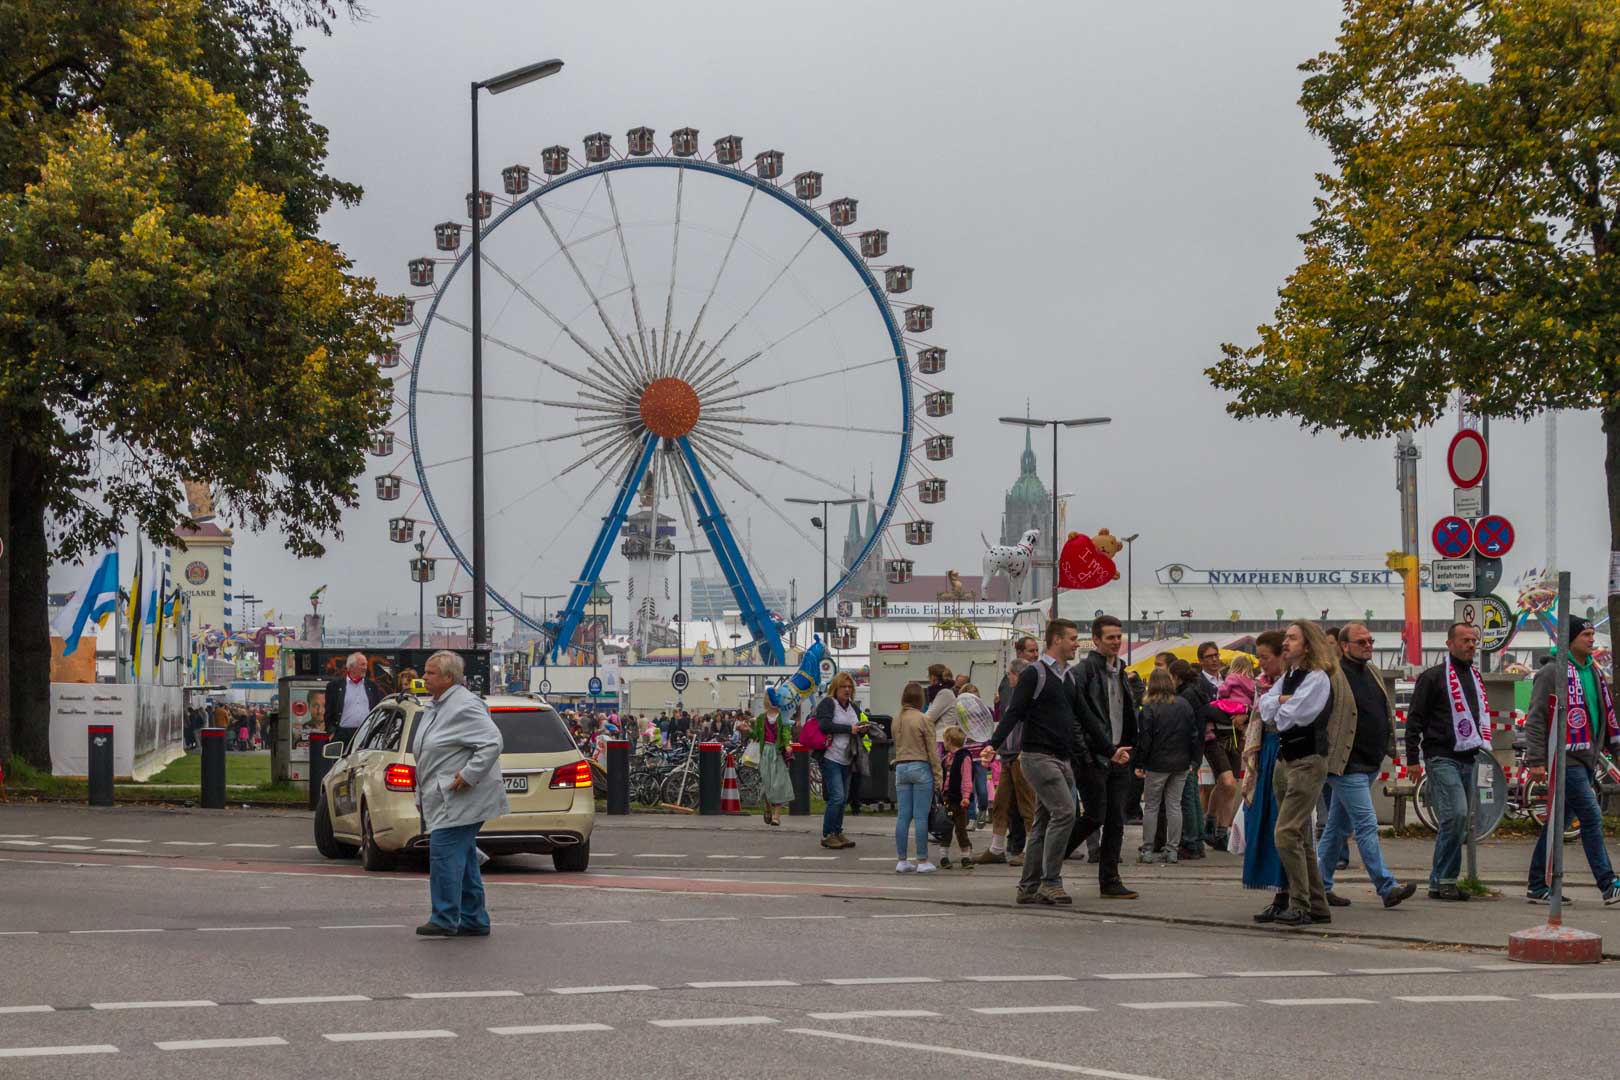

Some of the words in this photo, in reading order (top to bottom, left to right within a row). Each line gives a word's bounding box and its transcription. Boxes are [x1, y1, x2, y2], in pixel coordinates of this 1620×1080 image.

[1209, 571, 1341, 584] NYMPHENBURG
[1350, 570, 1392, 584] SEKT
[887, 605, 920, 615] nbräu.
[944, 605, 964, 615] Bier
[968, 605, 985, 615] wie
[503, 778, 526, 789] 760
